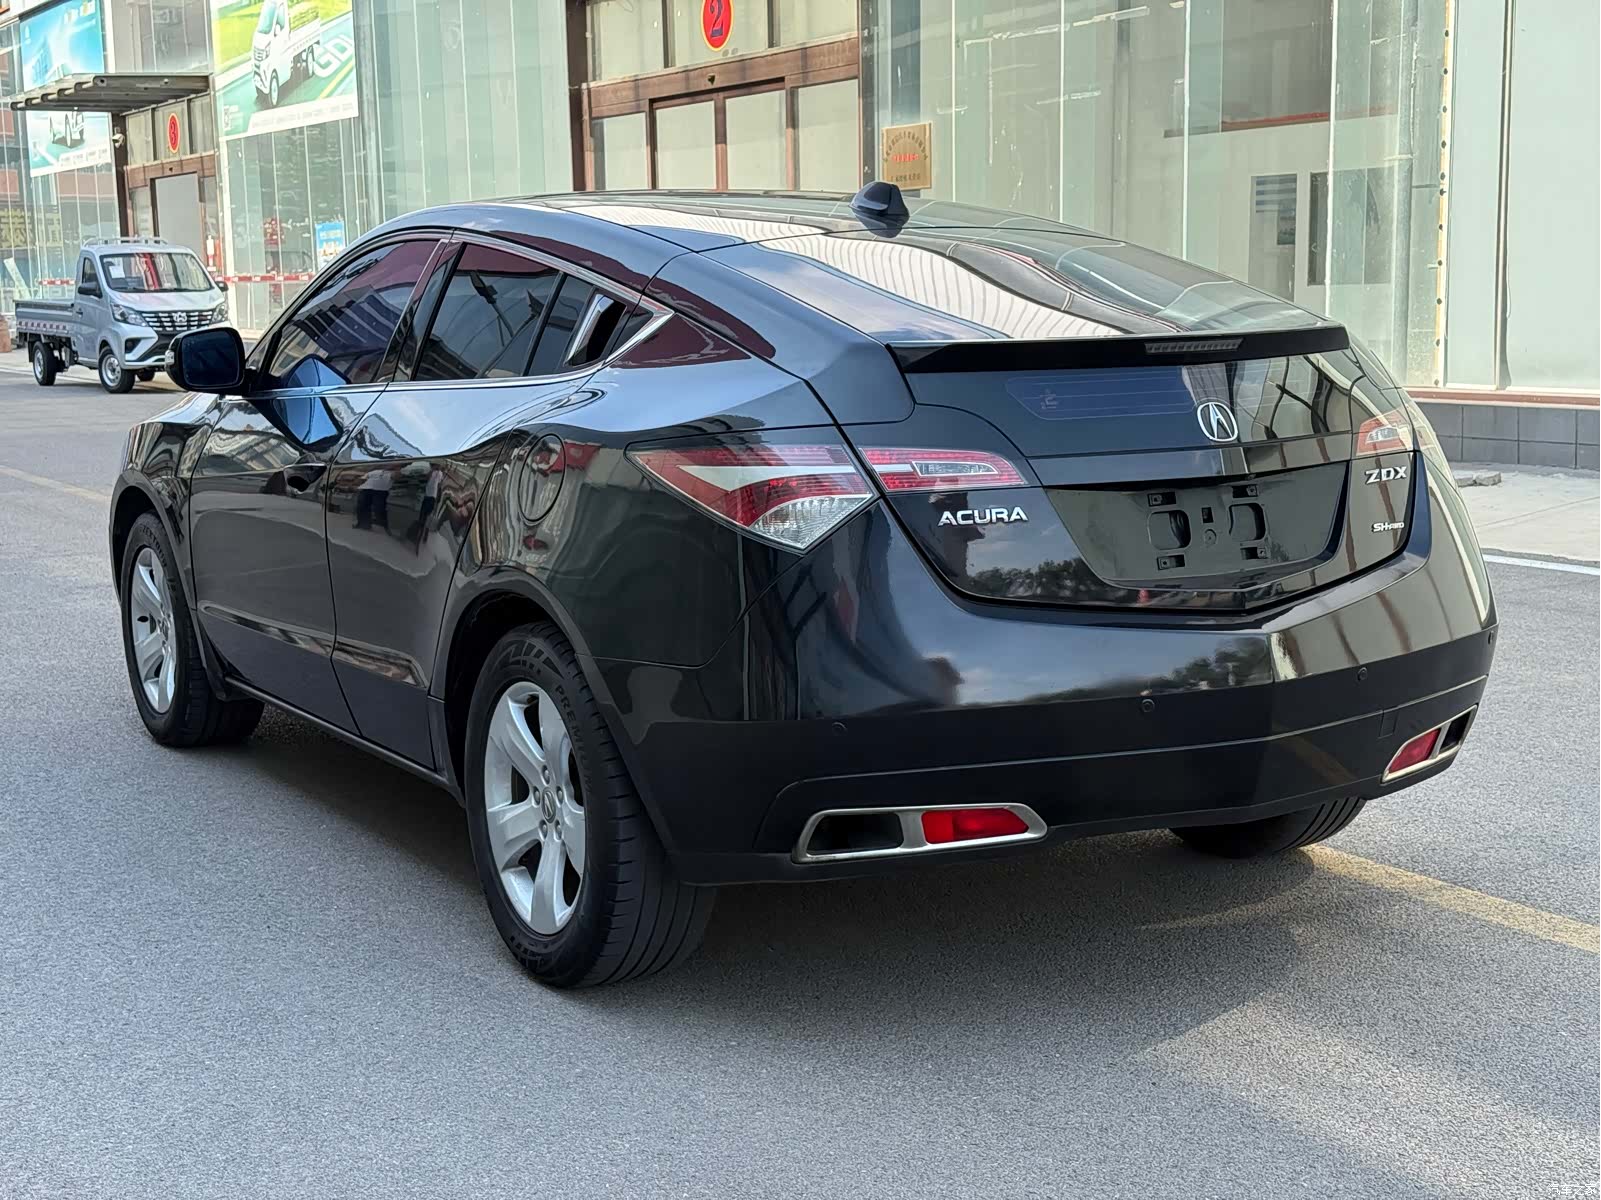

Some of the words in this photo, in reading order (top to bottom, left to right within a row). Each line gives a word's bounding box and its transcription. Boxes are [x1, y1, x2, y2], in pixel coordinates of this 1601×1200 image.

[709, 0, 724, 38] 2
[1364, 466, 1408, 485] ZDX
[937, 506, 1029, 527] ACURA
